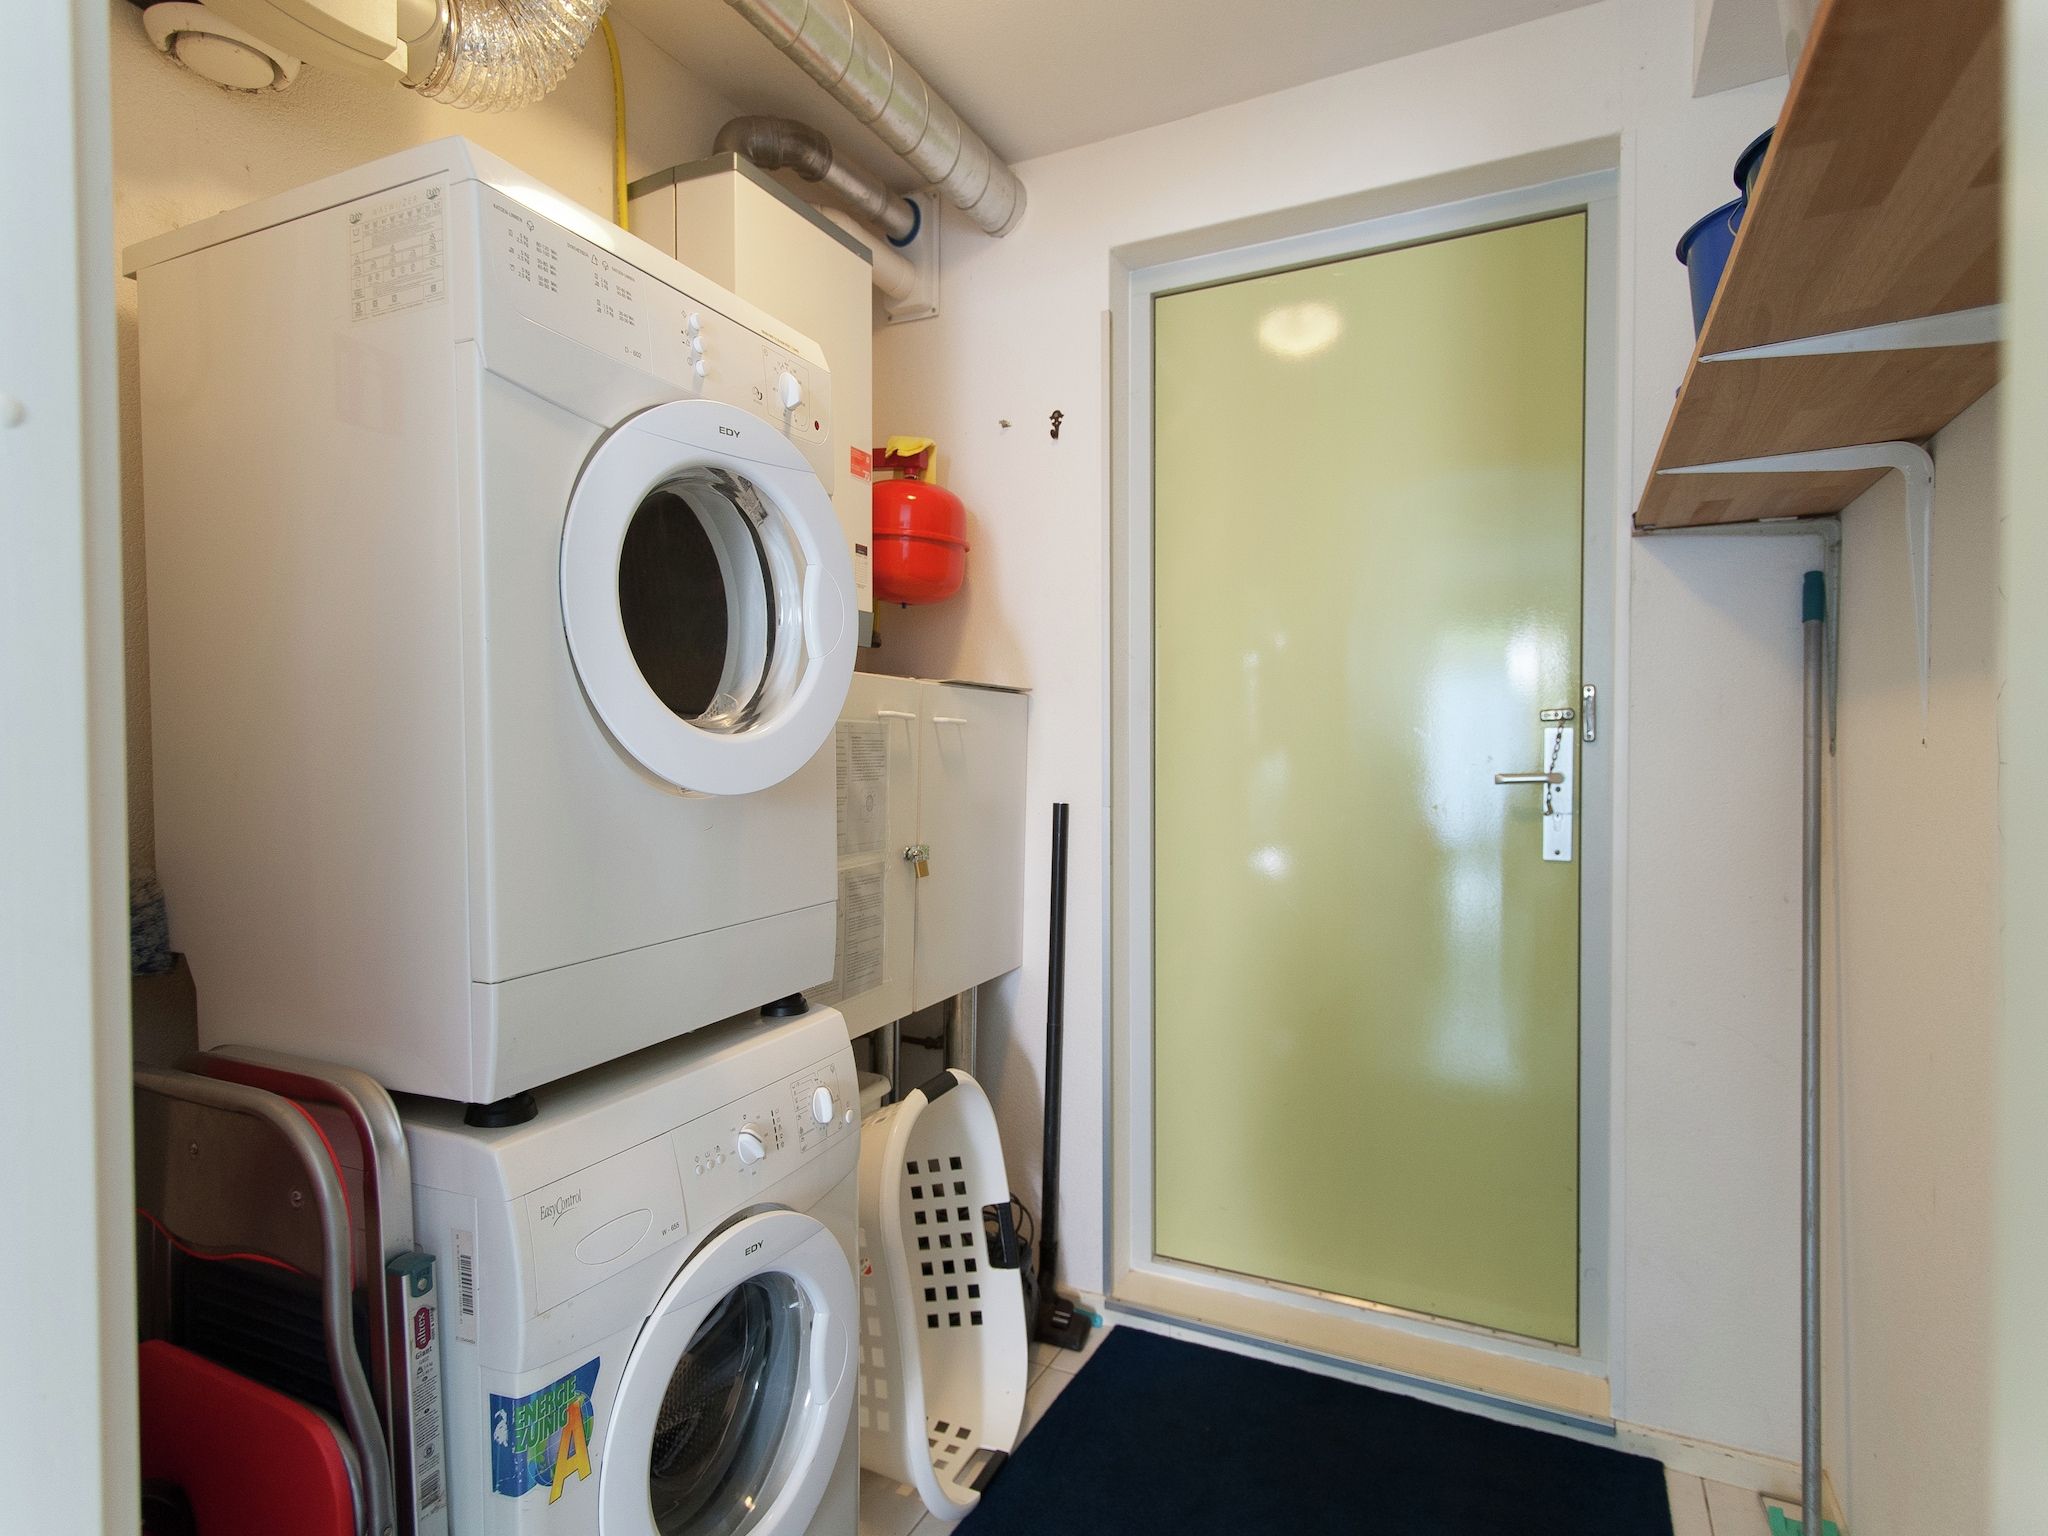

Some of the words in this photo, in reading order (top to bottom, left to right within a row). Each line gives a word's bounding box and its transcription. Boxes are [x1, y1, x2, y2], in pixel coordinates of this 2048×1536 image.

[718, 425, 741, 439] EDY
[540, 1187, 582, 1224] EasyControl
[744, 1239, 764, 1256] EDY
[415, 1345, 433, 1360] Giant
[514, 1375, 578, 1431] ENERGIE
